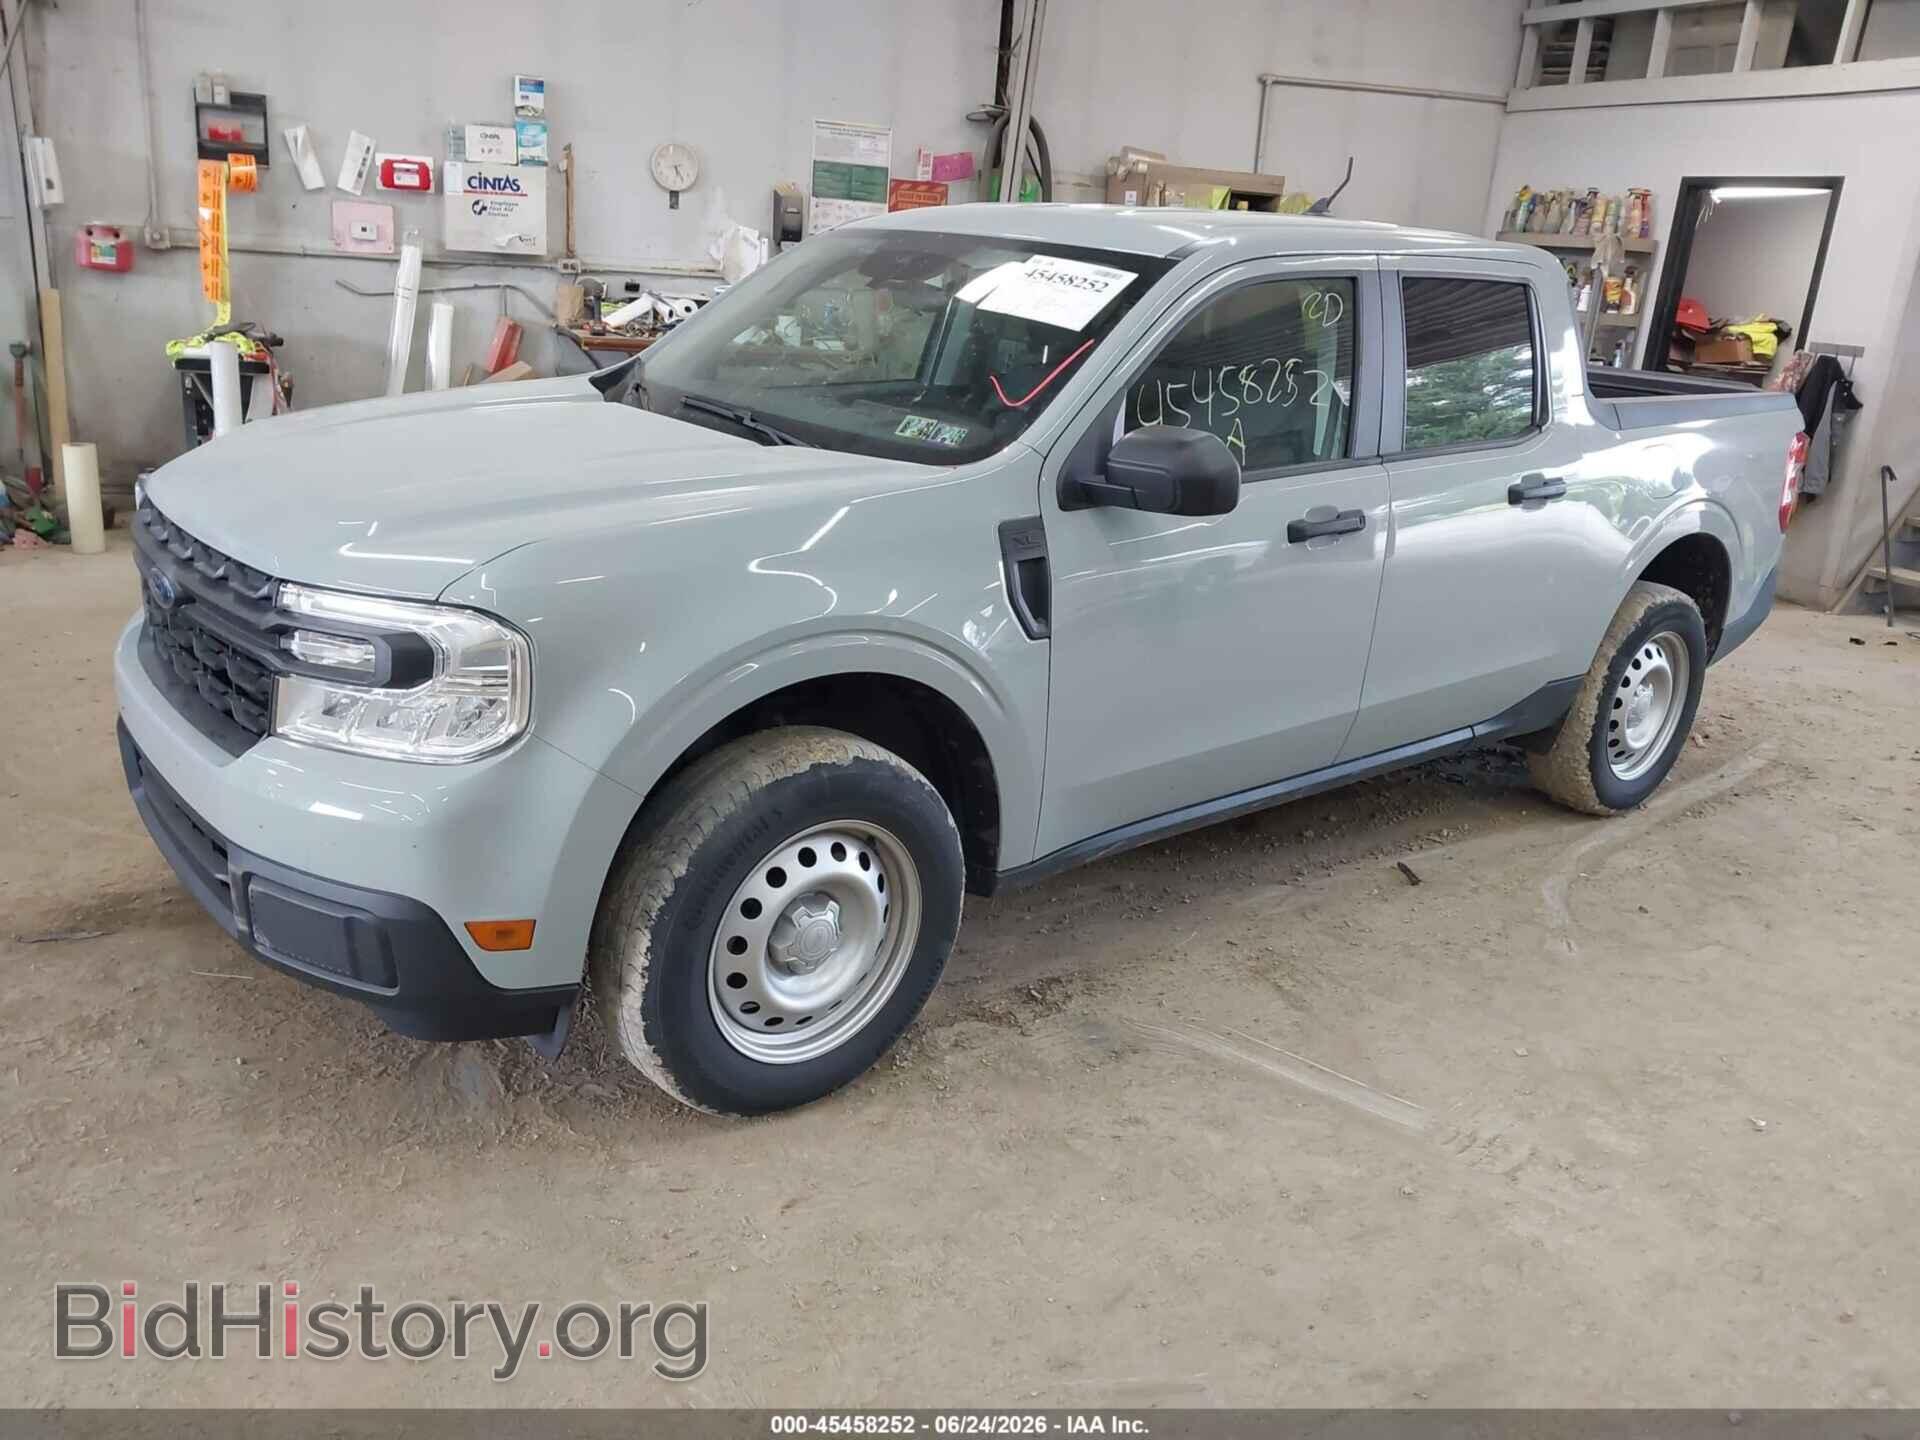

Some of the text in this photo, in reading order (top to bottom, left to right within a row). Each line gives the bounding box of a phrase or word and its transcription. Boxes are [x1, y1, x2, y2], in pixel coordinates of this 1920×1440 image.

[467, 172, 521, 192] CINTAS
[1024, 268, 1109, 293] 45458252
[1226, 418, 1246, 466] A
